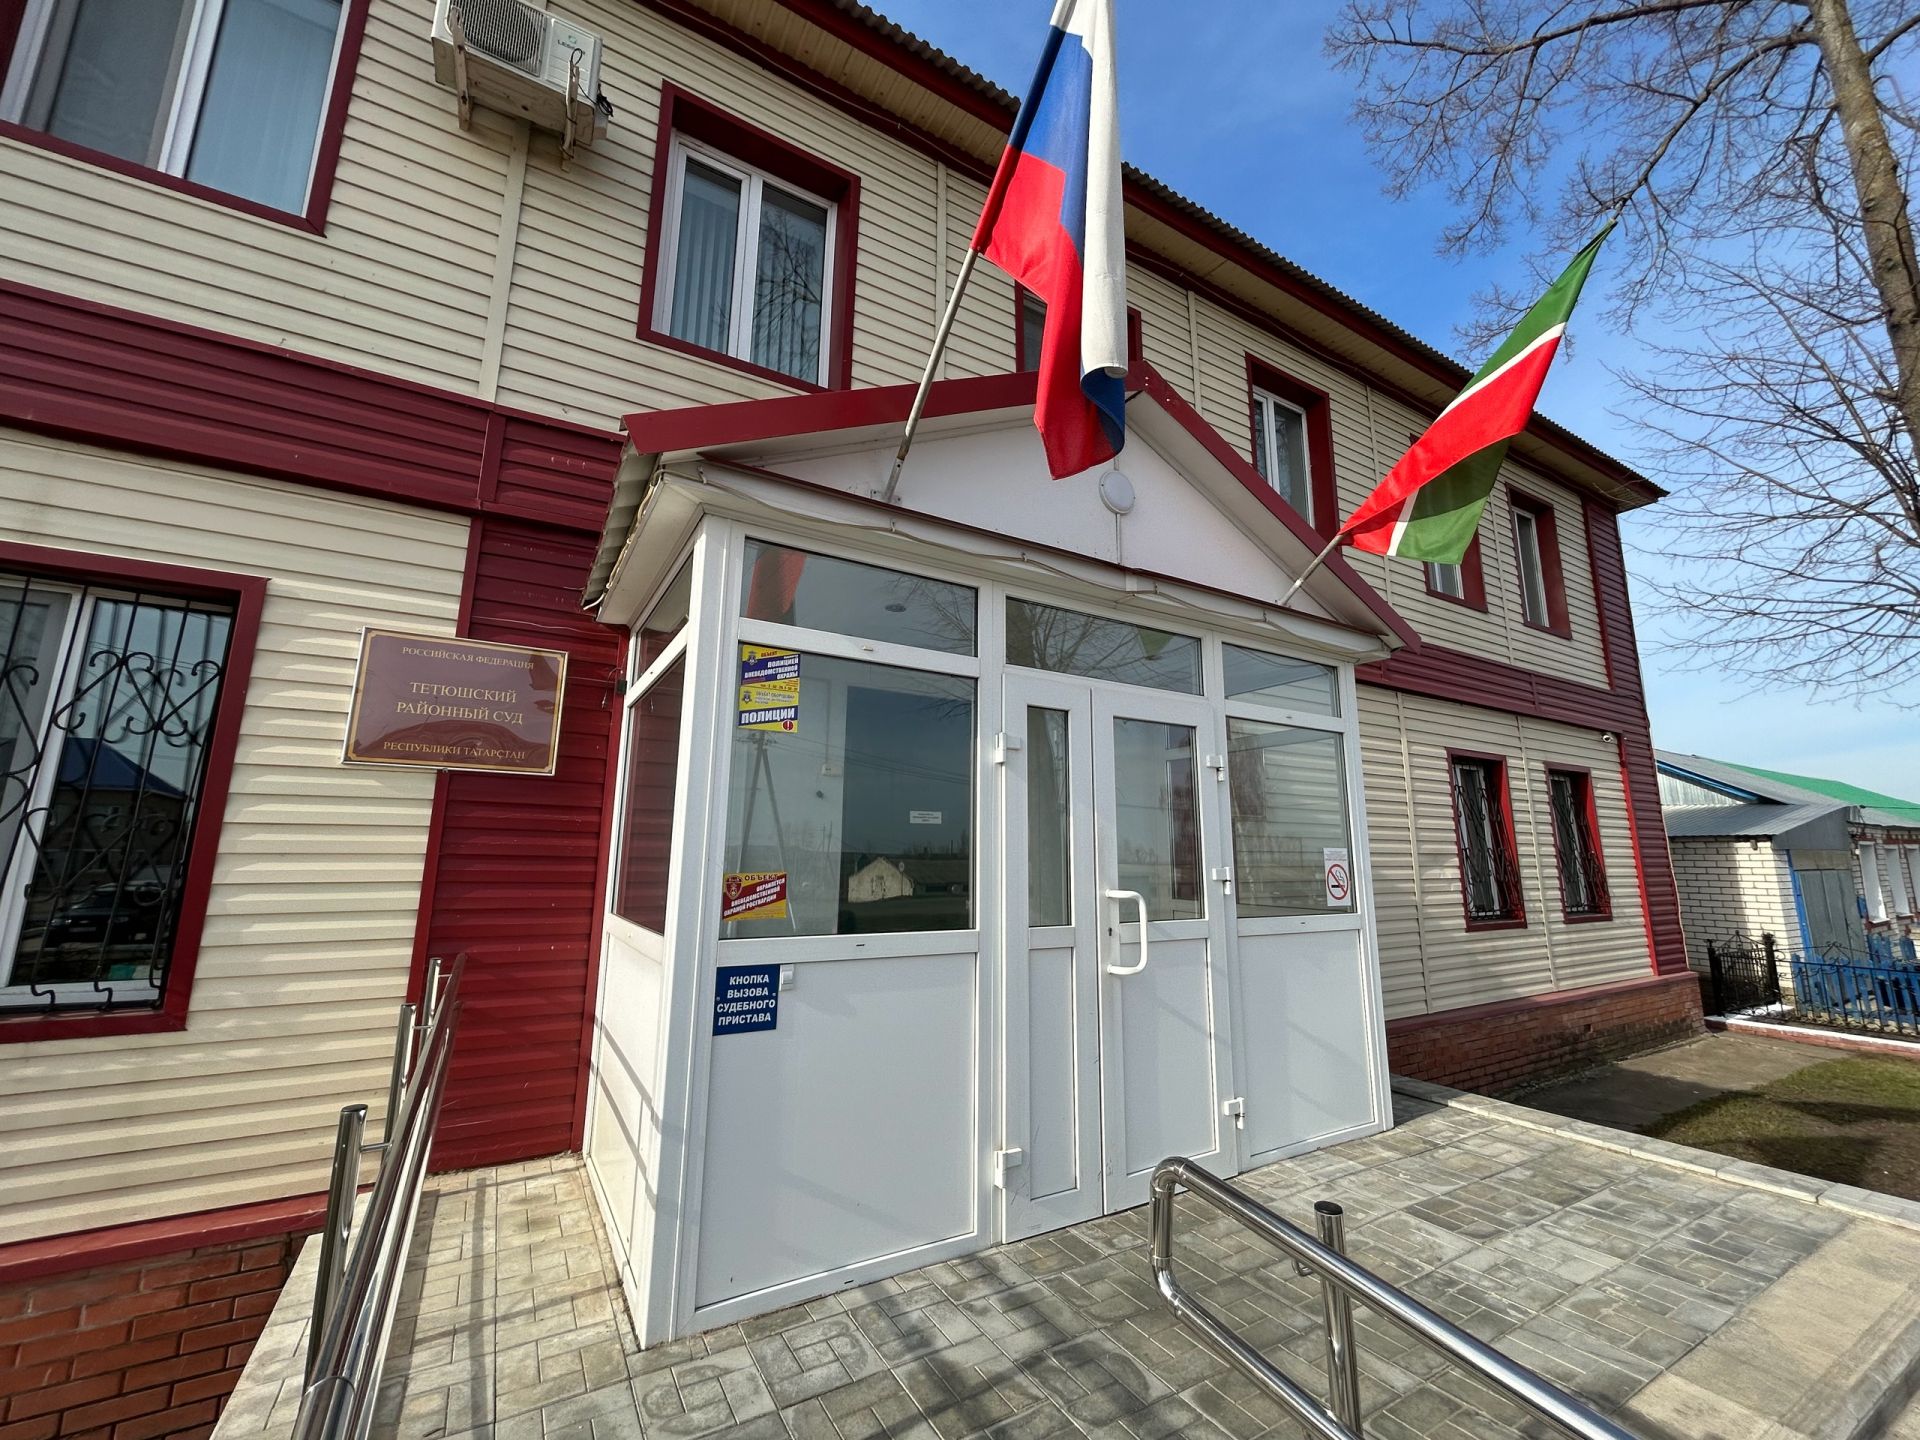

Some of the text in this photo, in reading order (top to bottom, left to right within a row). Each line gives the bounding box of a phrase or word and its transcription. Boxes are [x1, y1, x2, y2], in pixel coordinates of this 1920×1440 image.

[402, 646, 535, 670] РОССИЙСКАЯ ФЕДЕРАЦИЯ
[767, 657, 799, 668] ПОЛИЦИЕЙ
[744, 664, 798, 678] ВНЕВЕДОМСТВЕННОЙ
[776, 671, 798, 679] ОХРАНЫ
[409, 681, 517, 703] ТЕТЮШСКИЙ
[396, 701, 523, 725] РАЙОННЫЙ СУД
[741, 707, 795, 724] ПОЛИЦИИ
[383, 741, 526, 760] РЕСПУБЛИКИ ТАТАРСТАН
[729, 974, 770, 986] КНОПКА
[726, 987, 769, 999] ВЫЗОВА
[716, 999, 776, 1013] СУДЕБНОГО
[718, 1012, 771, 1026] ПРИСТАВА
